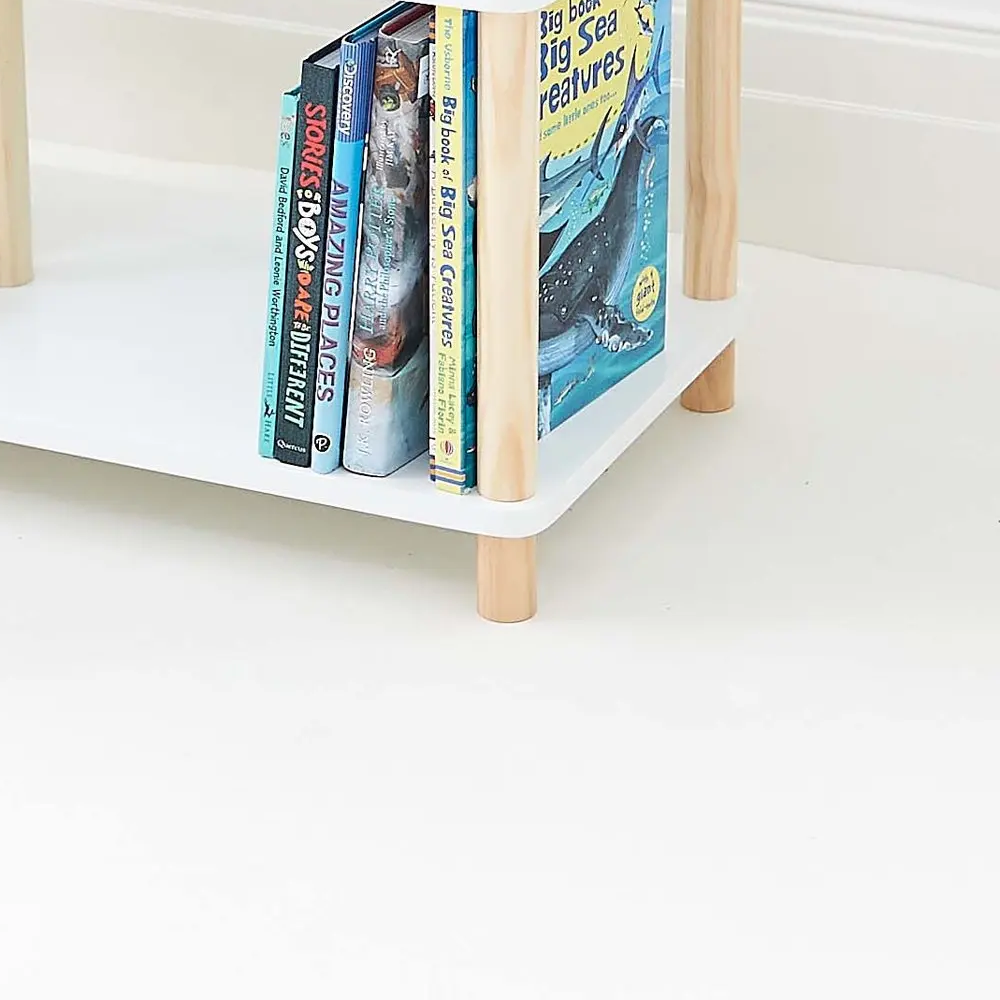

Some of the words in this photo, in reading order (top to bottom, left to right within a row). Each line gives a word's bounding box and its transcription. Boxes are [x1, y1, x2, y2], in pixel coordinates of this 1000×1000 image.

[444, 18, 453, 40] The
[578, 9, 618, 55] Sea
[539, 44, 626, 121] reatures
[440, 96, 457, 125] Big
[301, 102, 328, 189] STORIES
[440, 128, 457, 166] book
[278, 167, 290, 194] David
[442, 169, 454, 182] of
[276, 197, 288, 234] Bedford
[365, 186, 385, 258] POTTER
[439, 186, 457, 219] Big
[274, 235, 284, 254] and
[292, 201, 322, 262] BOYS
[324, 180, 350, 297] AMAZING
[441, 224, 456, 259] Sea
[273, 256, 284, 286] Leonie
[268, 289, 281, 347] Worthington
[294, 272, 313, 321] DARE
[358, 262, 378, 334] HARRY
[439, 264, 456, 348] Creatures
[316, 303, 341, 403] PLACES
[284, 330, 312, 429] DIFFERENT
[360, 347, 376, 424] ROWLING
